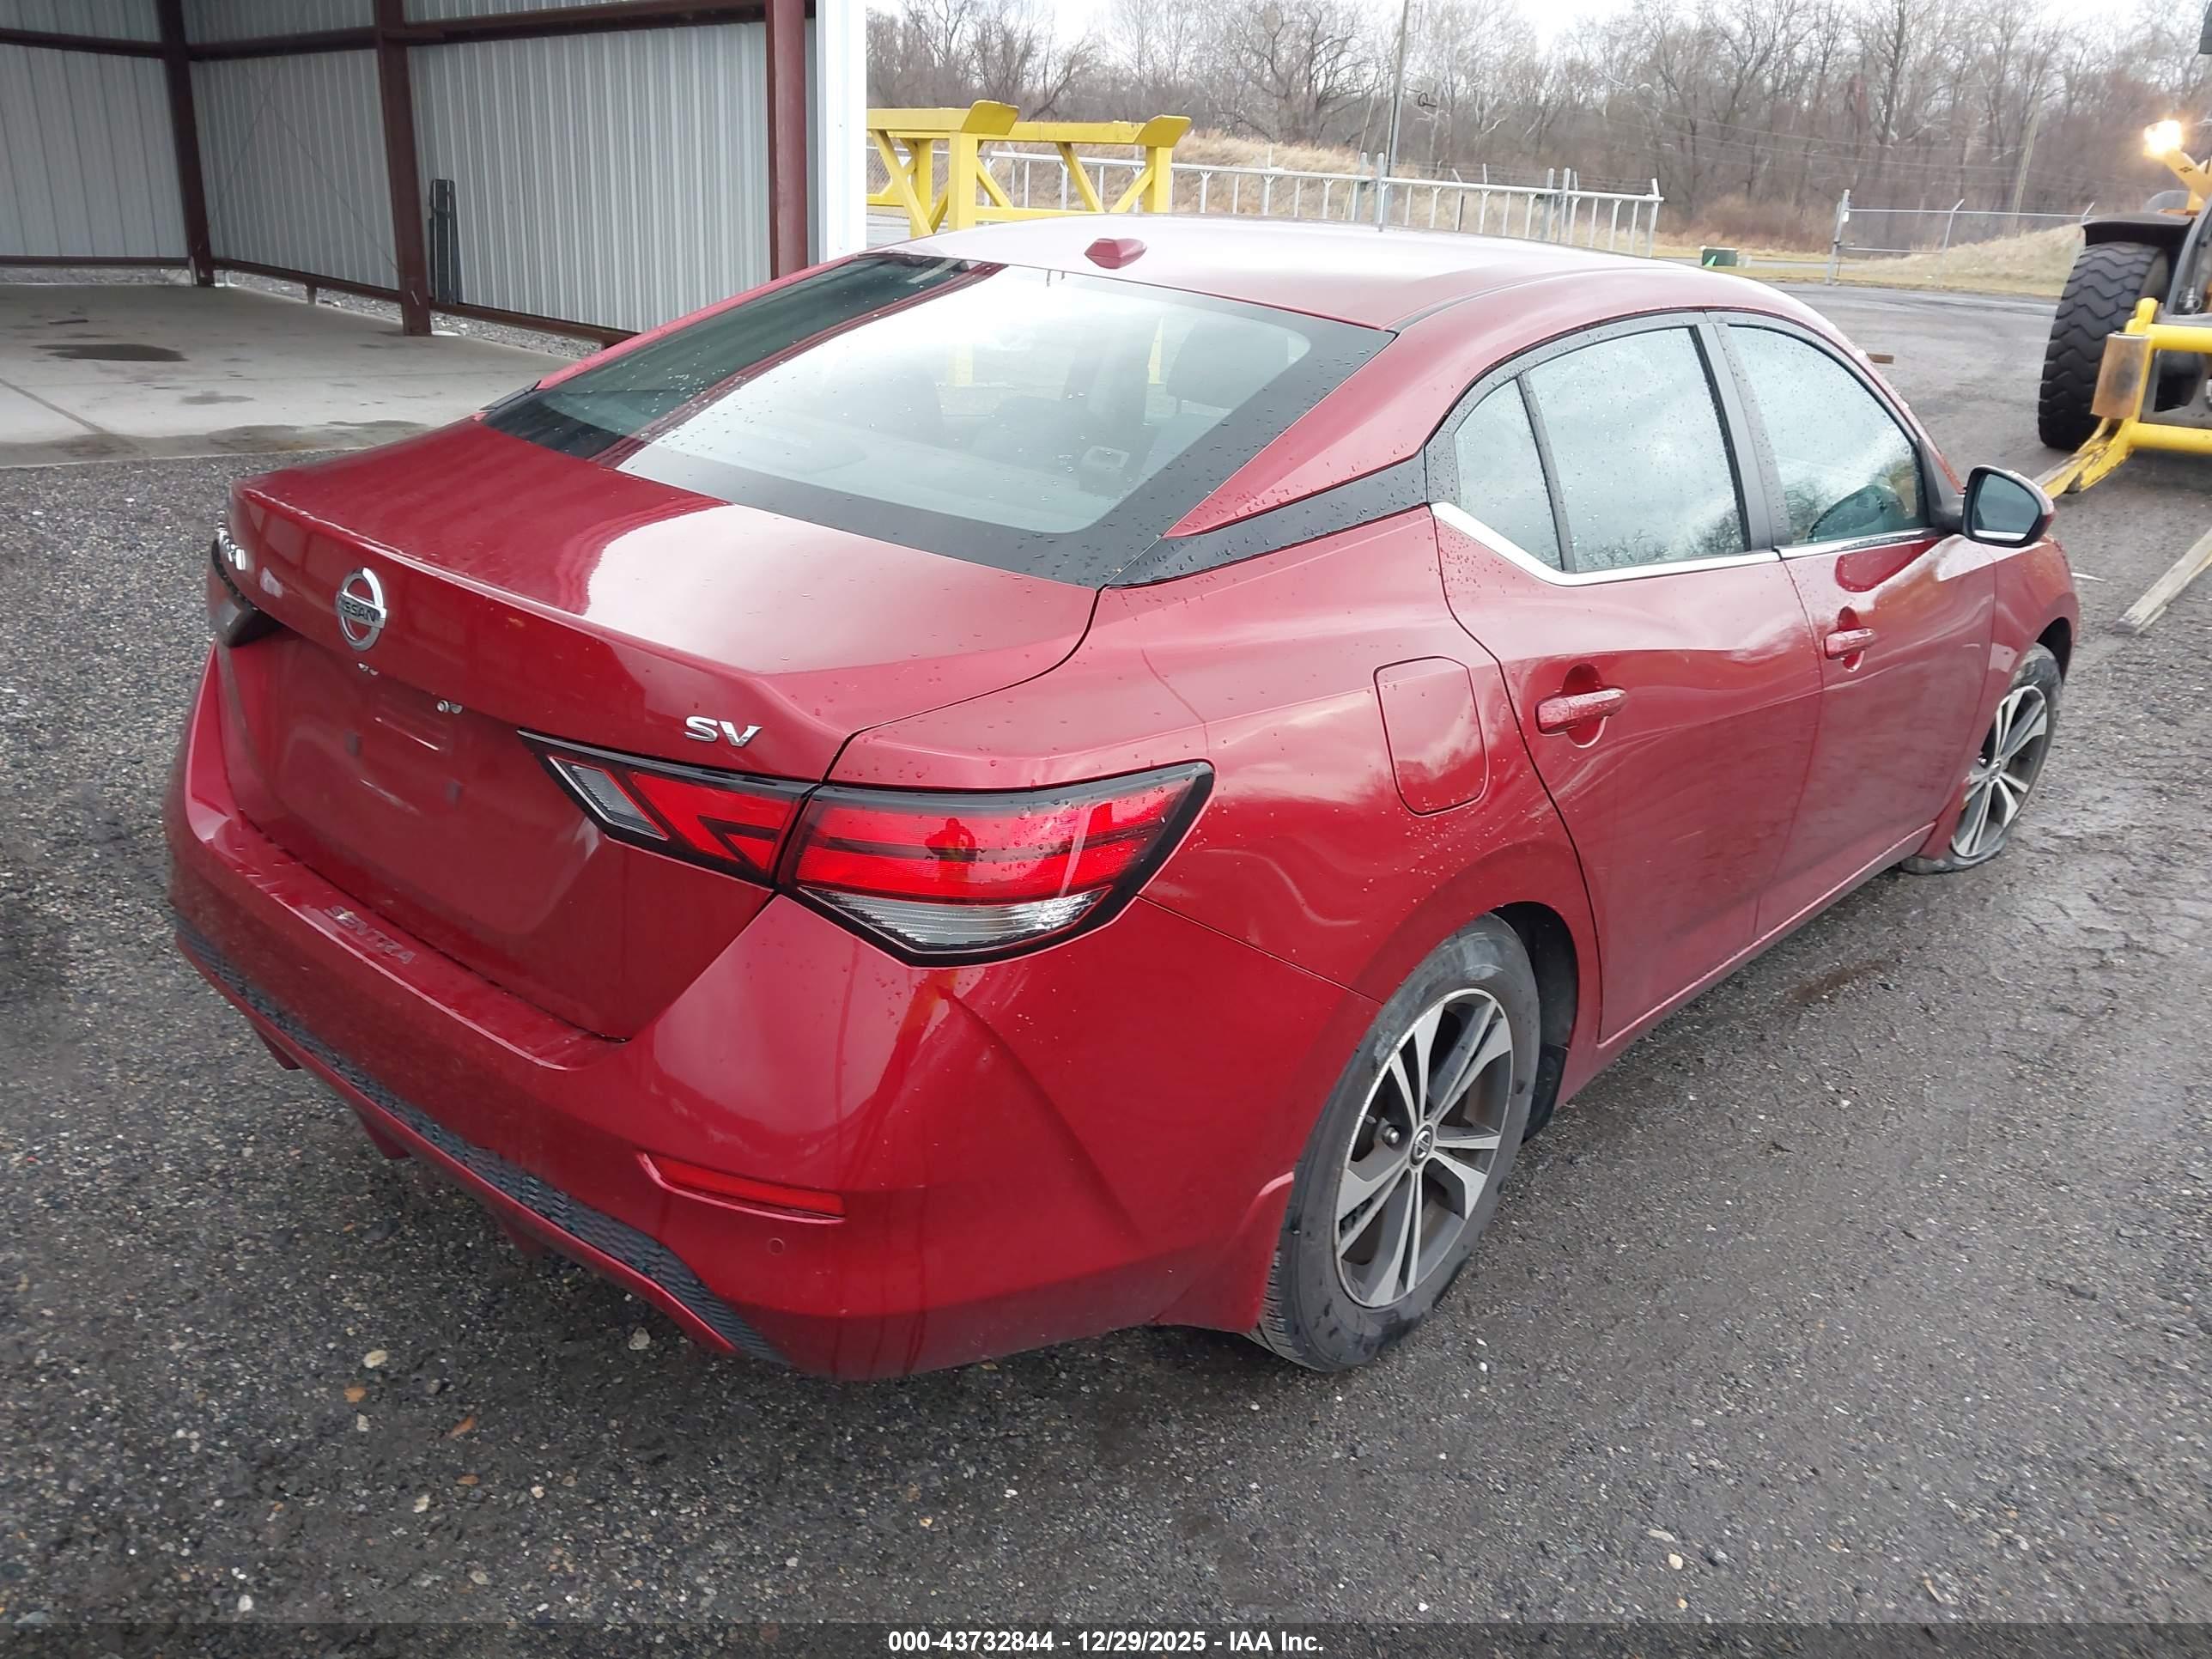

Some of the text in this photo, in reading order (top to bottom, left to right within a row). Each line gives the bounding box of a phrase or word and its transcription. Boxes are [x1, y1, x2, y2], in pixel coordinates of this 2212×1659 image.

[337, 597, 376, 623] SSAN
[684, 715, 763, 747] SV
[324, 905, 416, 963] SENTRA
